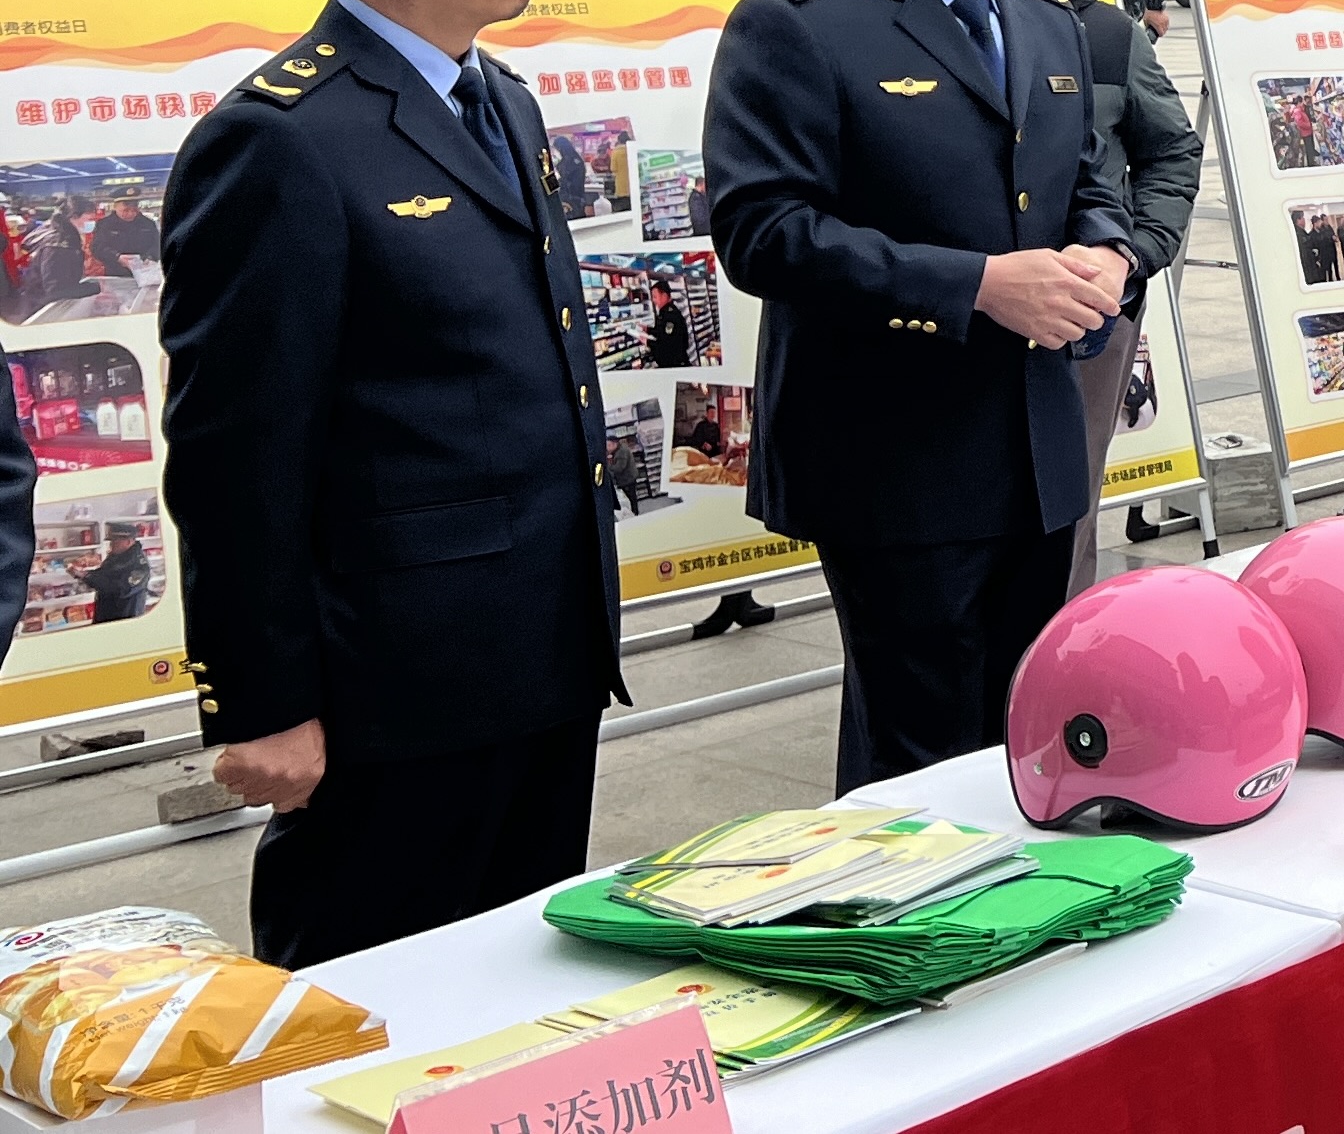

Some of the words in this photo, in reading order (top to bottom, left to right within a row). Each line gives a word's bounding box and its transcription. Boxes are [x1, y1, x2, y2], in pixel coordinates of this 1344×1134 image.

[521, 2, 590, 17] 费者权益日
[538, 66, 692, 96] 加强监督管理
[16, 91, 218, 126] 维护市场秩序
[679, 539, 818, 575] 宝鸡市金台区市场监督
[489, 1048, 718, 1134] 添加剂
